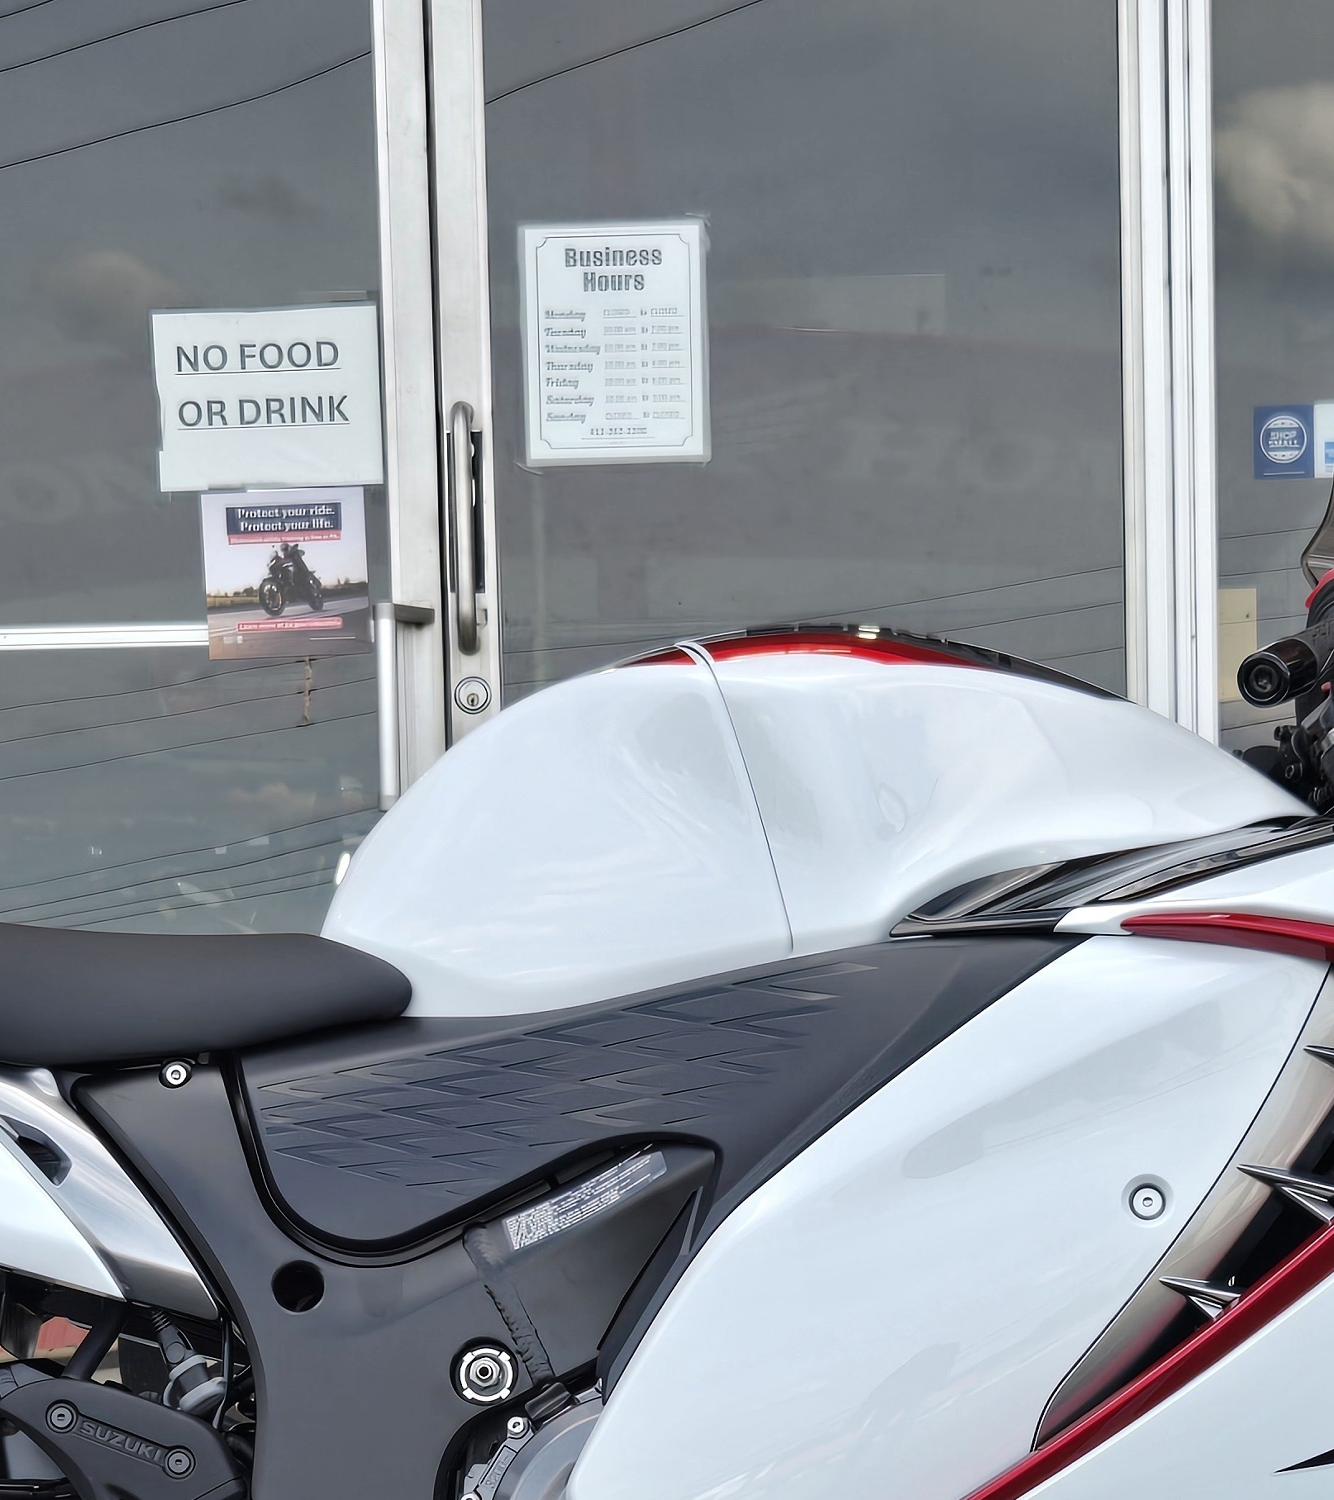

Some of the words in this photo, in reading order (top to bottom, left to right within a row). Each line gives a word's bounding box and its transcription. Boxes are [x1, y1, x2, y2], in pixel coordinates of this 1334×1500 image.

[564, 246, 664, 269] Business
[582, 271, 646, 293] Hours
[176, 343, 229, 373] NO
[239, 340, 341, 371] FOOD
[177, 399, 229, 427] OR
[238, 394, 351, 426] DRINK
[238, 508, 279, 519] Protect
[282, 508, 307, 519] your
[309, 505, 335, 516] ride.
[240, 521, 282, 532] Protect
[284, 521, 310, 532] your
[312, 518, 334, 529] life.
[79, 1420, 164, 1462] SUZUKI
